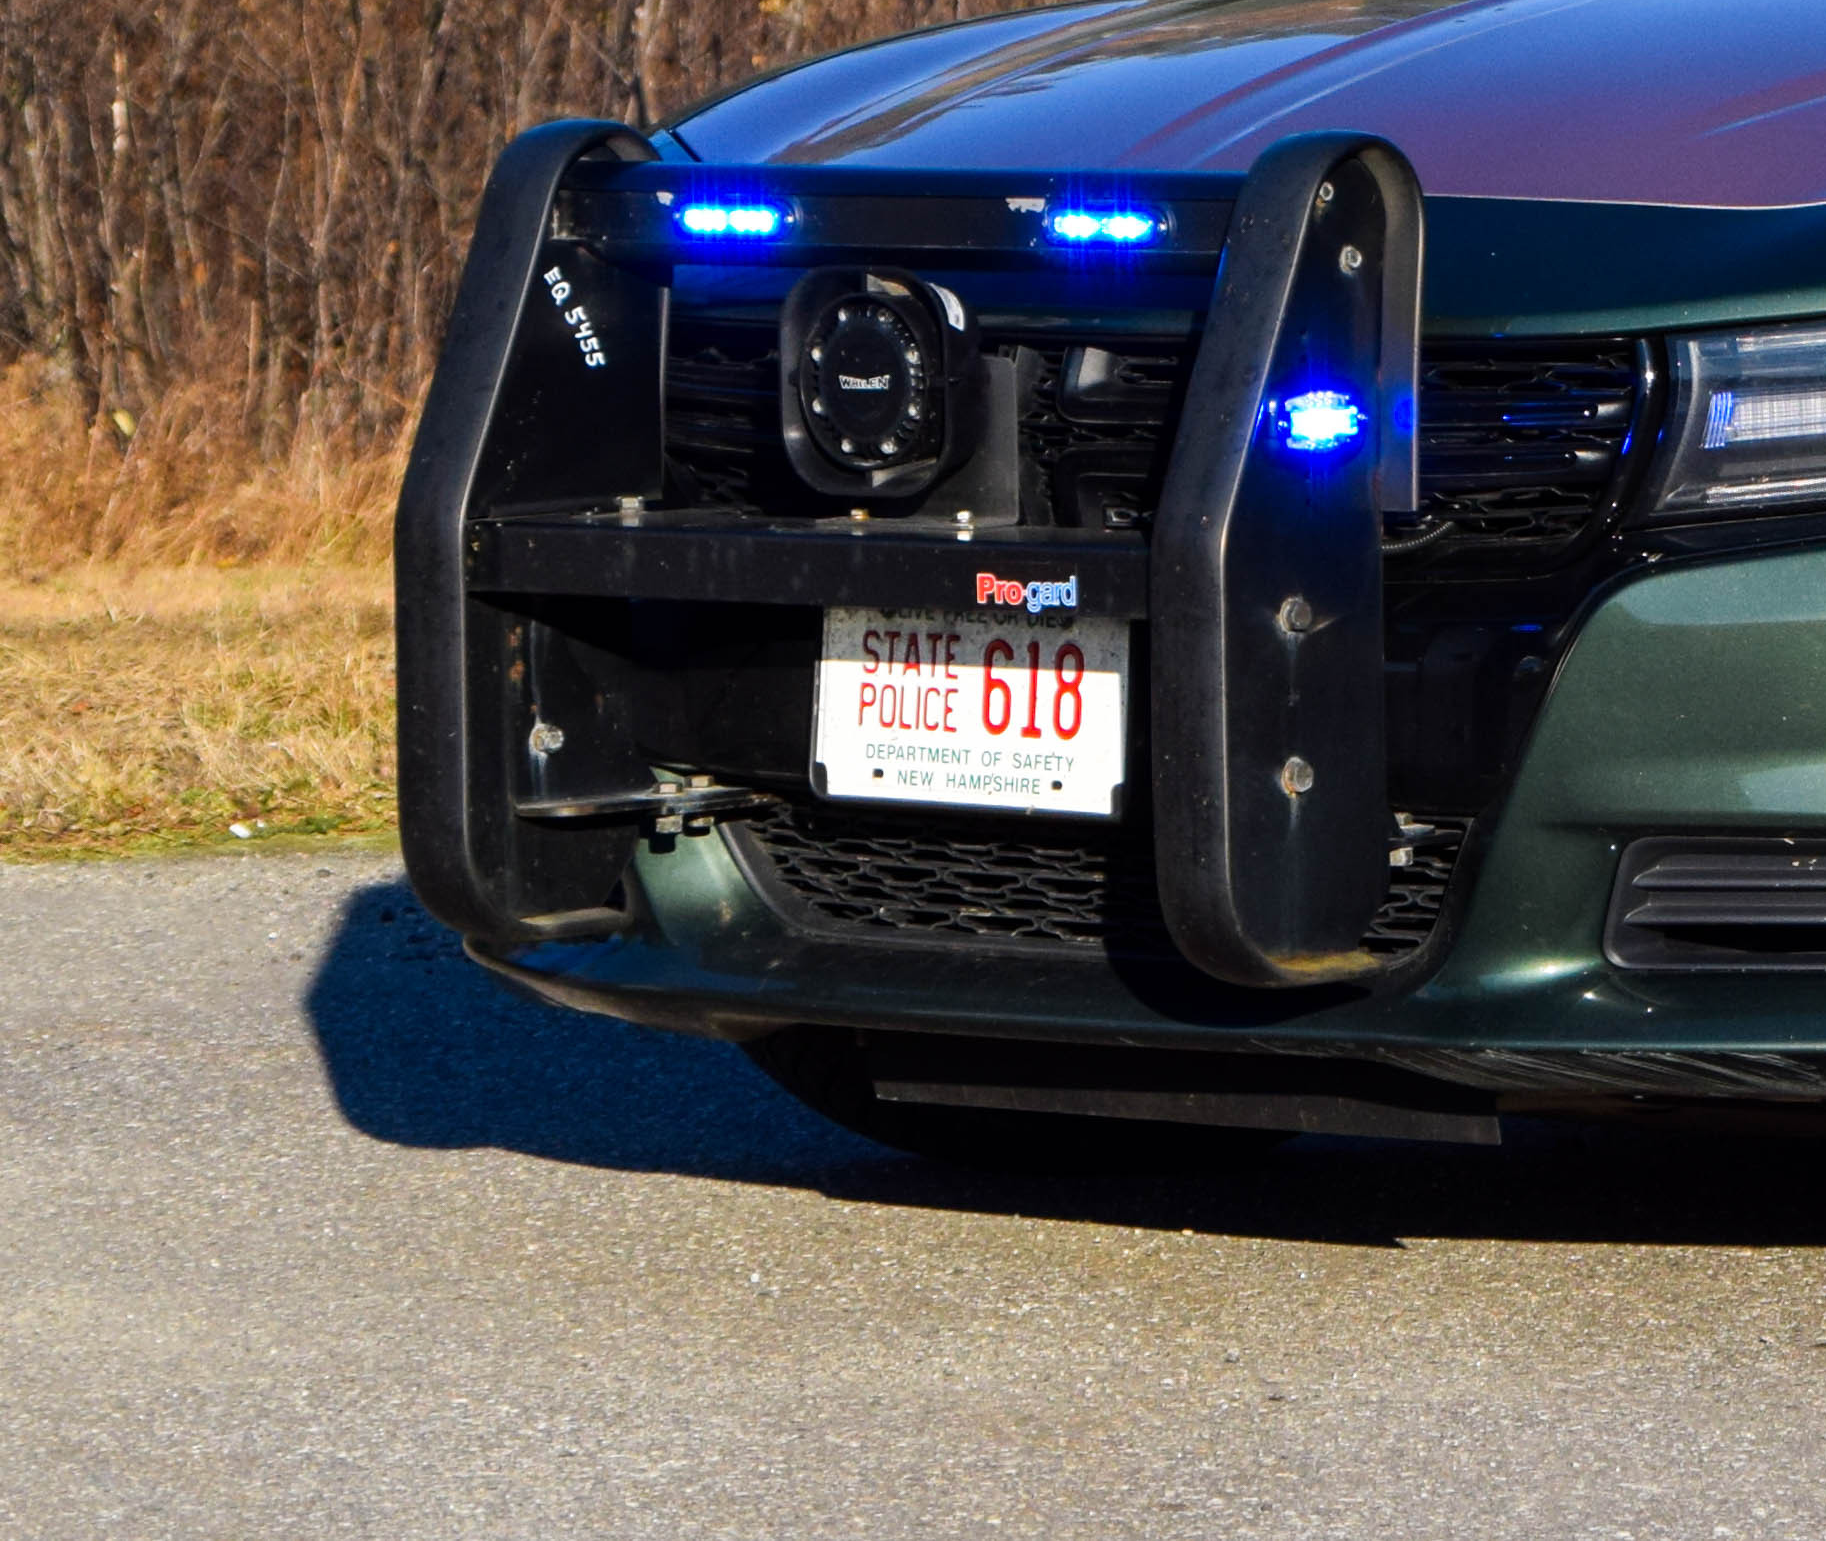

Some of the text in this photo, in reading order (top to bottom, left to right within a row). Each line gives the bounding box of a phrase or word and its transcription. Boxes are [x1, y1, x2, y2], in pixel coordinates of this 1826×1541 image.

[543, 266, 606, 367] EQ 5455
[862, 629, 962, 680] STATE
[858, 682, 959, 733] POLICE
[981, 638, 1085, 740] 618
[865, 743, 1075, 772] DEPARTMENT OF SAFETY
[897, 770, 1042, 795] NEW HAMPSHIRE
